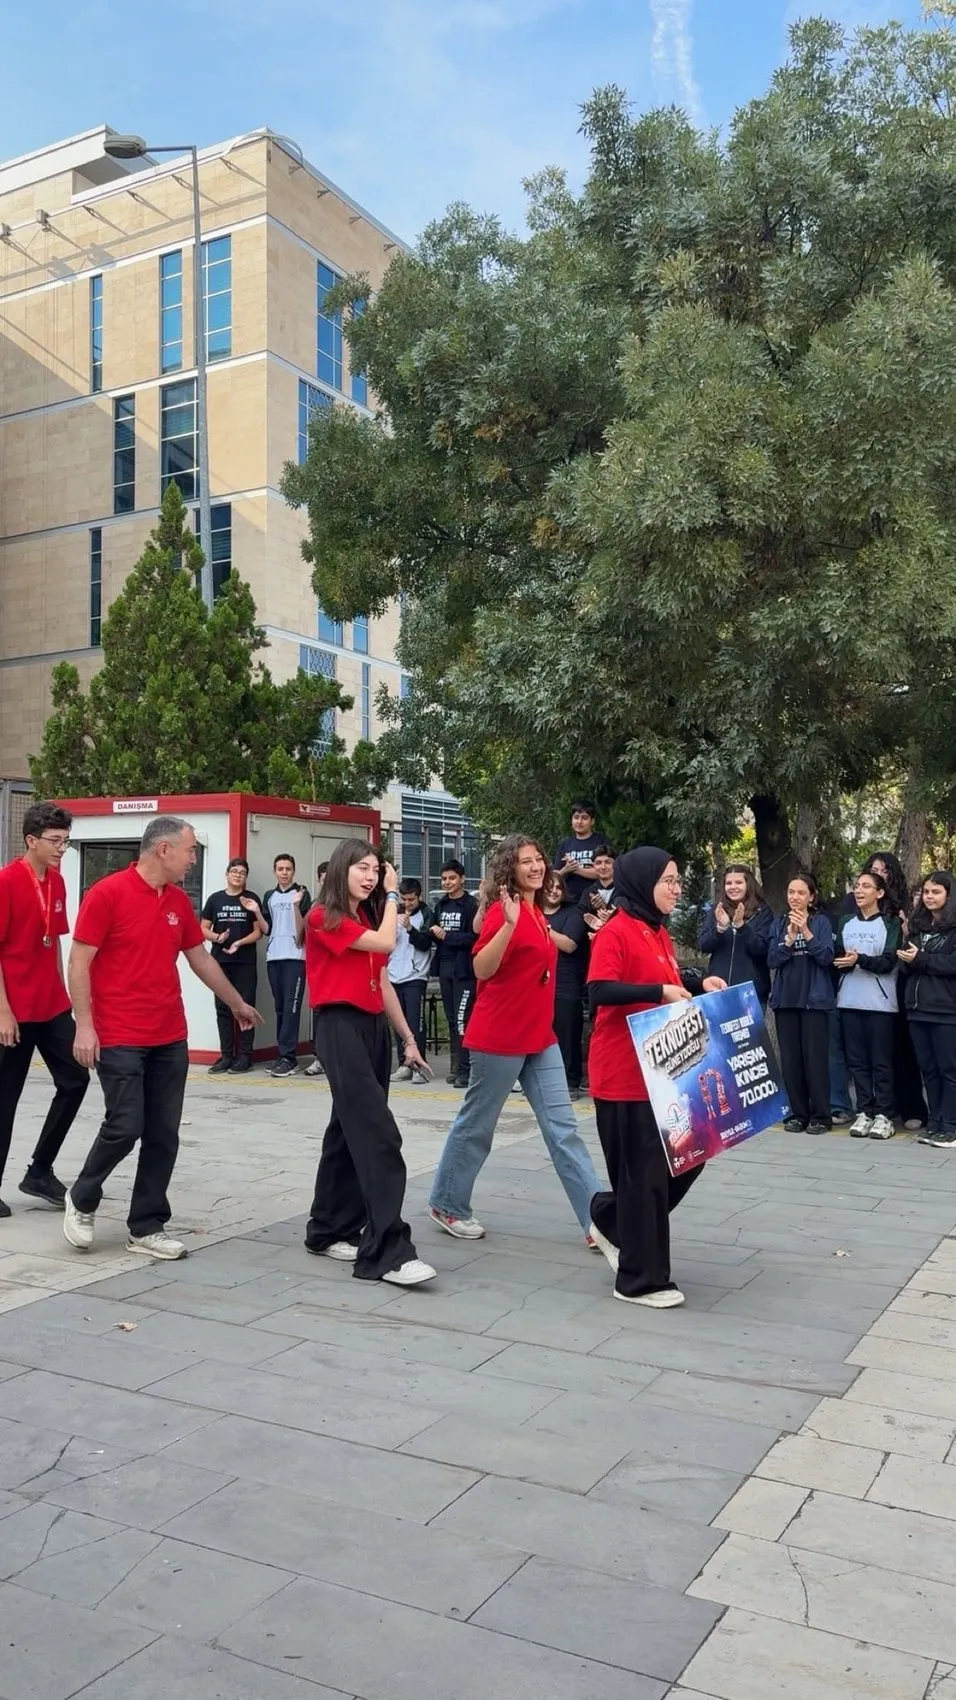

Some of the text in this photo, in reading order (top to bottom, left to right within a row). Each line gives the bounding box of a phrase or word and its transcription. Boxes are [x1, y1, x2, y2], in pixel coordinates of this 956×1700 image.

[645, 1011, 703, 1068] TEKNOFEST
[665, 1038, 700, 1072] GÜNEYDOĞU
[726, 1046, 767, 1071] YARIŞMA
